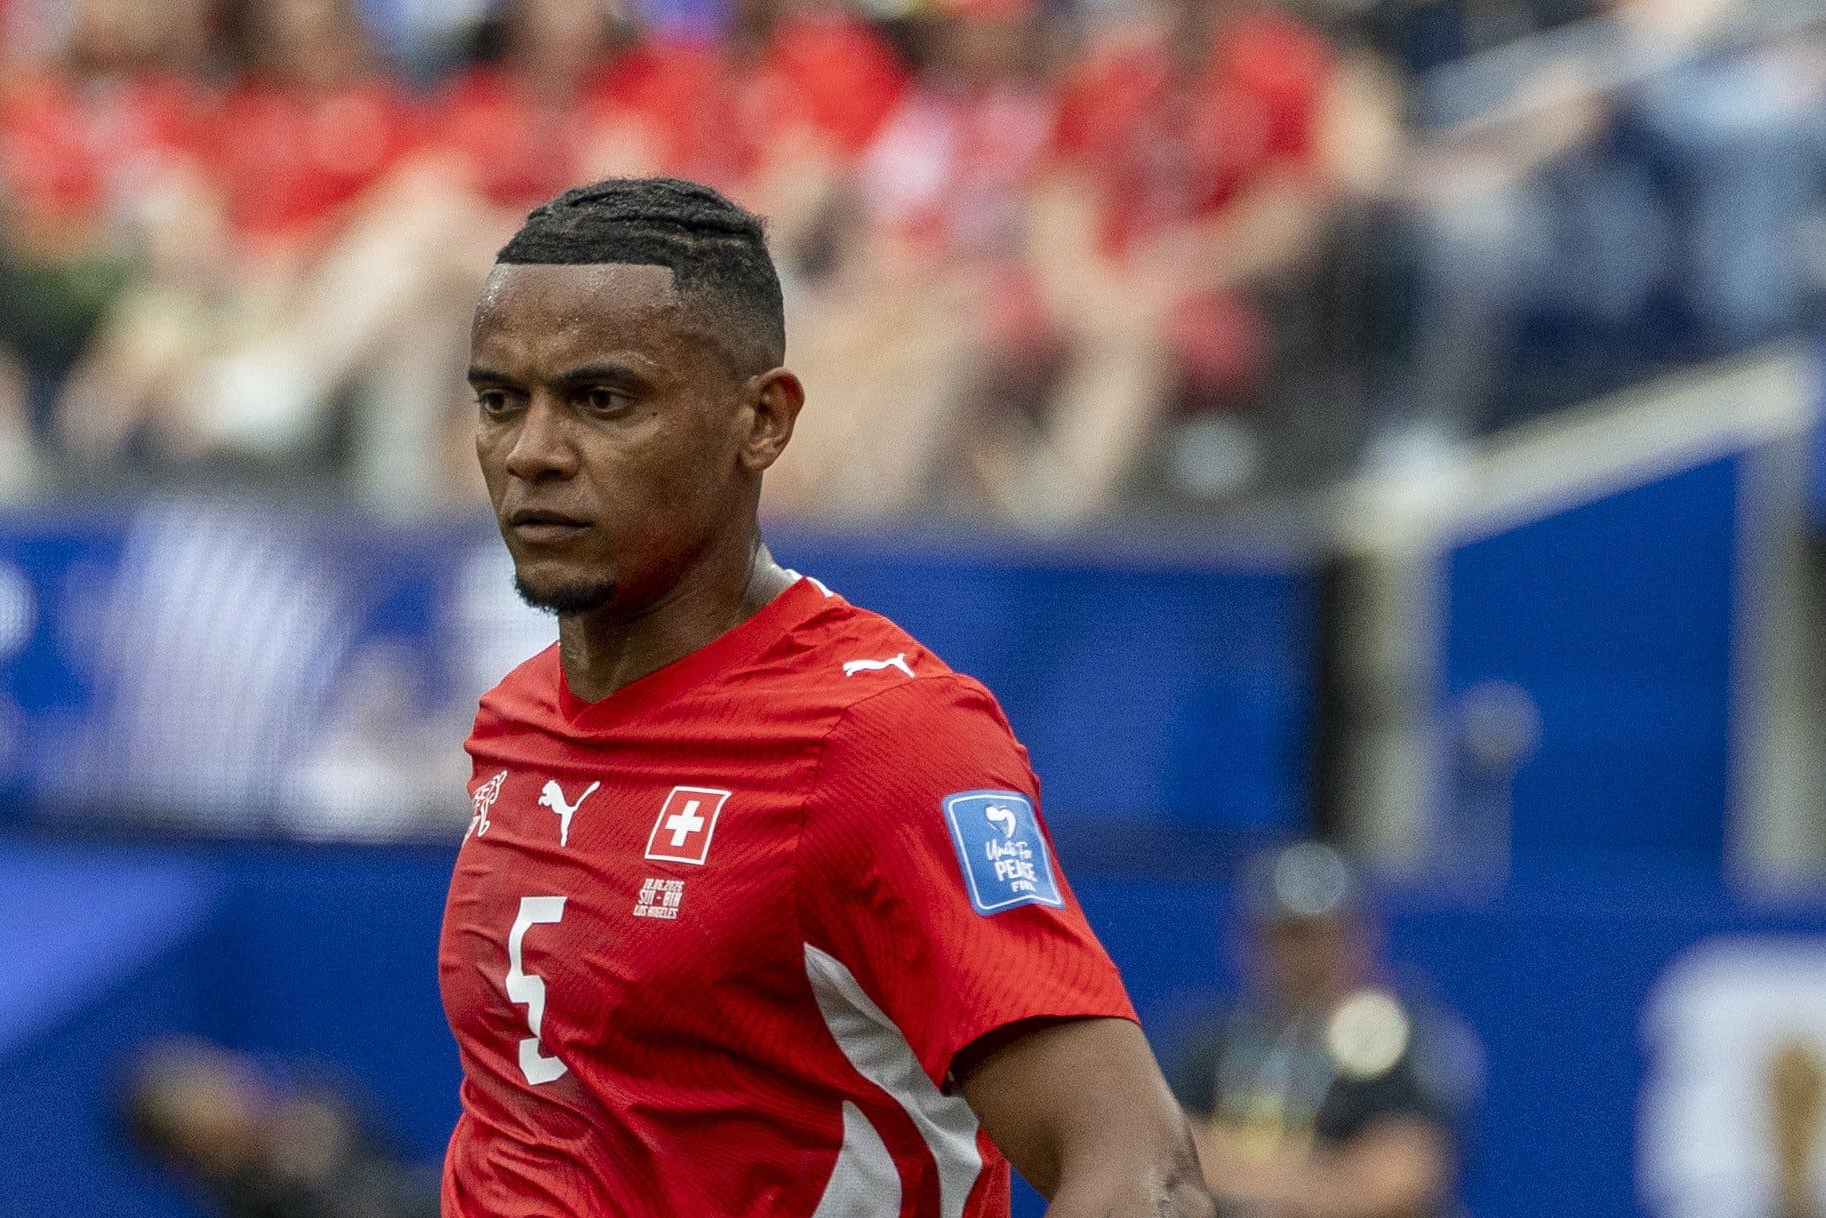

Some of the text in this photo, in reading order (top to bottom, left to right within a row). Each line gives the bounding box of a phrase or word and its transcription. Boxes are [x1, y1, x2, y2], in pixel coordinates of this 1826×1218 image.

[638, 889, 655, 905] SUI
[662, 891, 683, 907] BIH
[633, 904, 679, 920] LOS ANGELES
[505, 895, 568, 1085] 5
